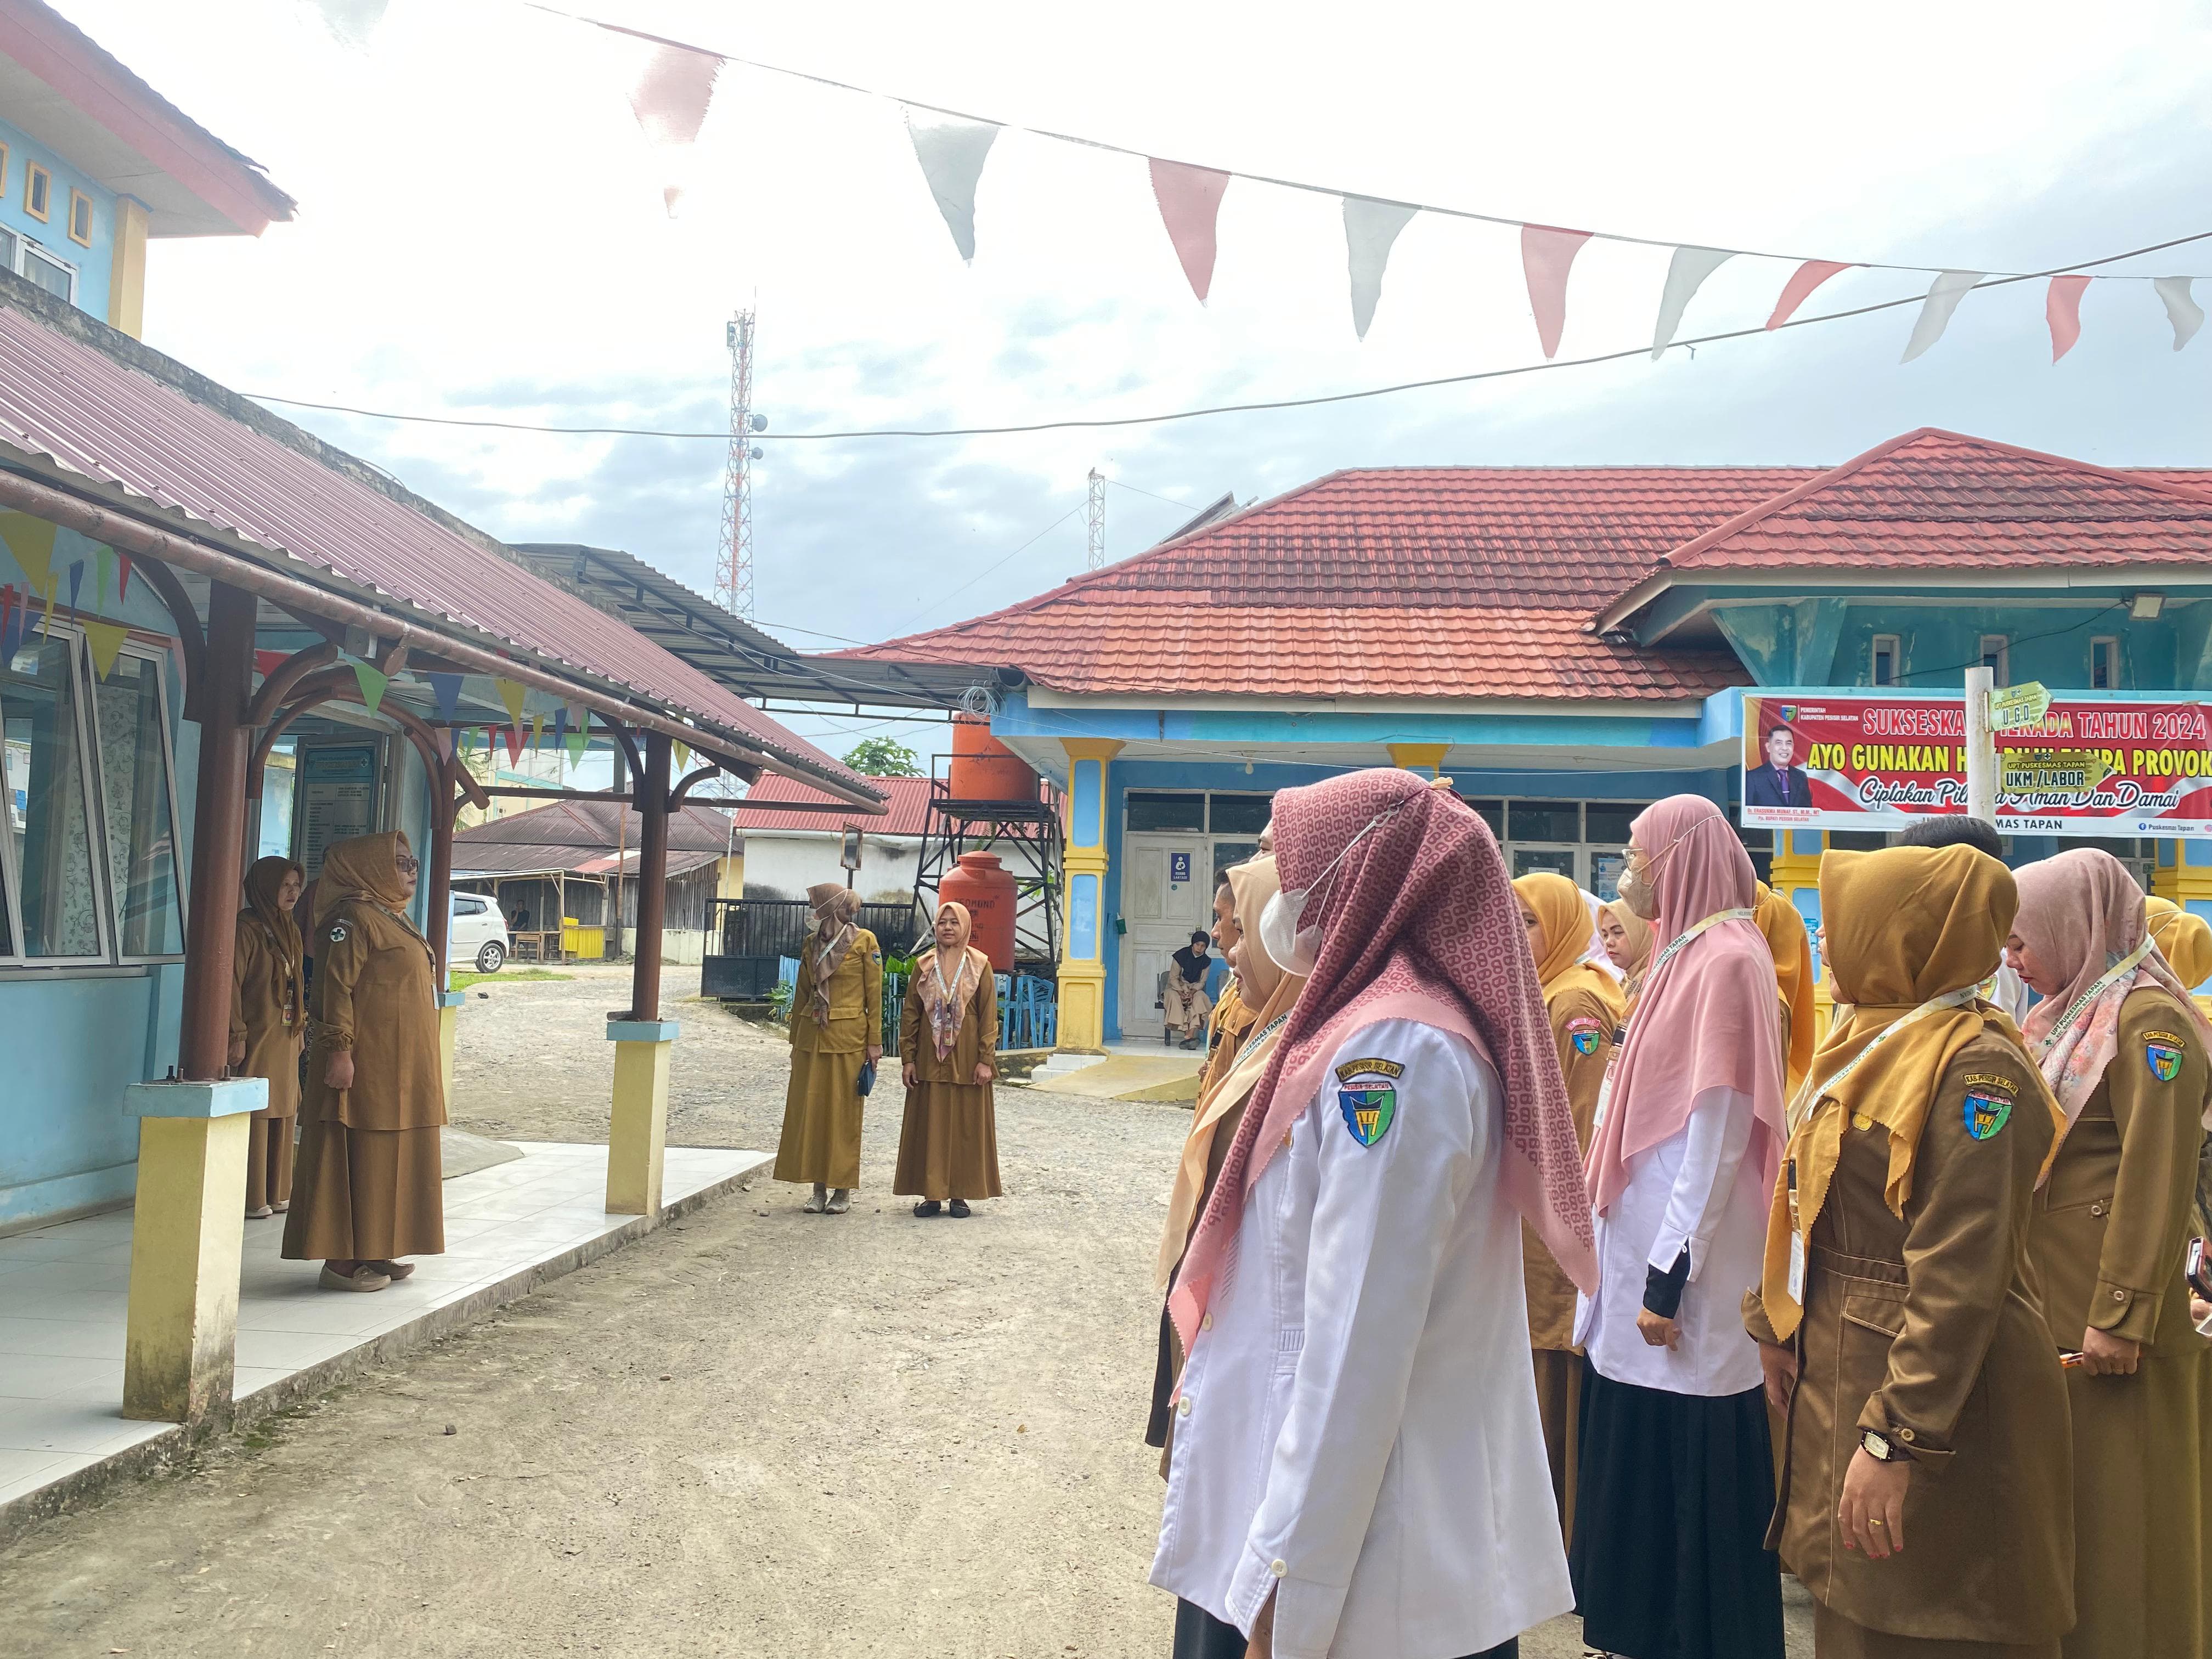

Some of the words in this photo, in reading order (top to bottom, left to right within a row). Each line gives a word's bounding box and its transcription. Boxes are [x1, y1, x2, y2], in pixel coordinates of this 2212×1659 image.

[1863, 708, 1966, 736] SUKSESKA
[2078, 712, 2148, 740] TAHUN
[2153, 713, 2207, 740] 2024
[1807, 743, 1846, 771] AYO
[1852, 743, 1949, 772] GUNAKAN
[1860, 777, 1936, 810] Ciptakan
[2116, 782, 2179, 808] Damai
[2006, 771, 2033, 787] UKM
[2023, 819, 2063, 830] TAPAN
[2051, 1024, 2061, 1035] UPT
[2058, 996, 2086, 1026] PUSKESMAS
[2084, 980, 2103, 997] TAPAN
[1266, 1014, 1287, 1031] TAPAN
